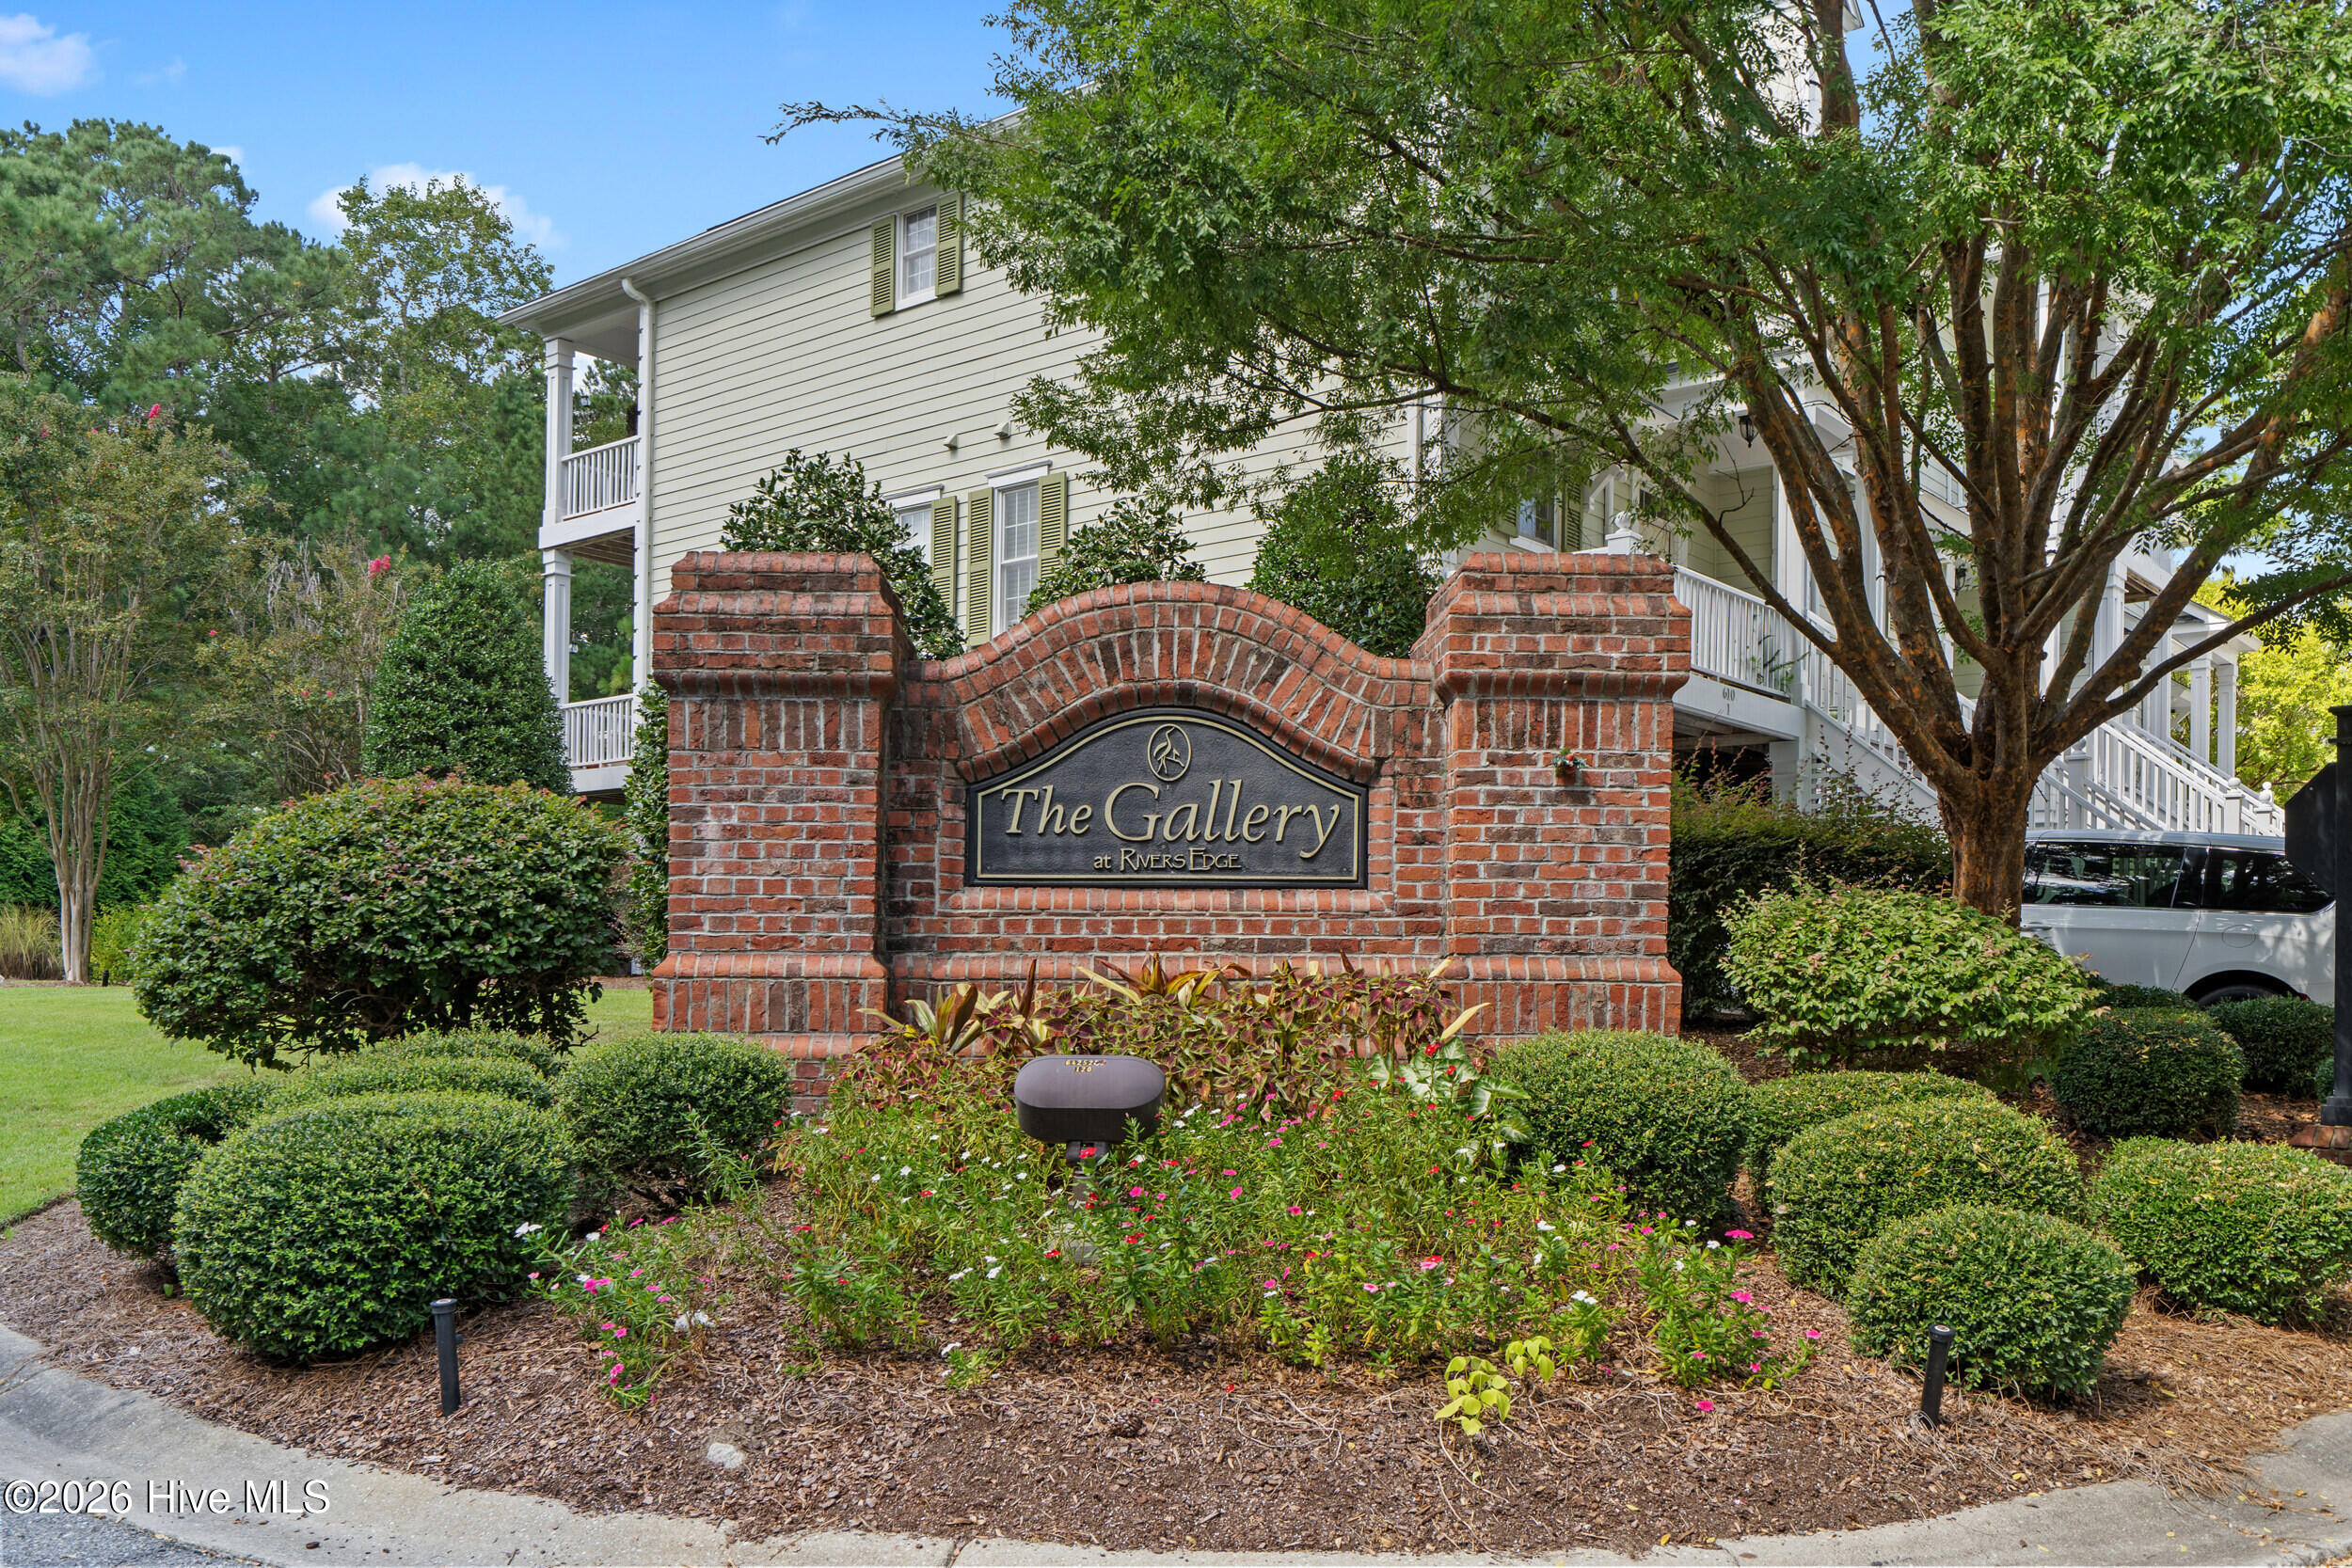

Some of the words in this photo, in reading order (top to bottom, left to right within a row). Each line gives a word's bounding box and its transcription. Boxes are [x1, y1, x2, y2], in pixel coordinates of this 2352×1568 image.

[1723, 686, 1736, 701] 610
[1001, 784, 1092, 835] The
[1104, 779, 1341, 859] Gallery
[1093, 854, 1111, 869] at
